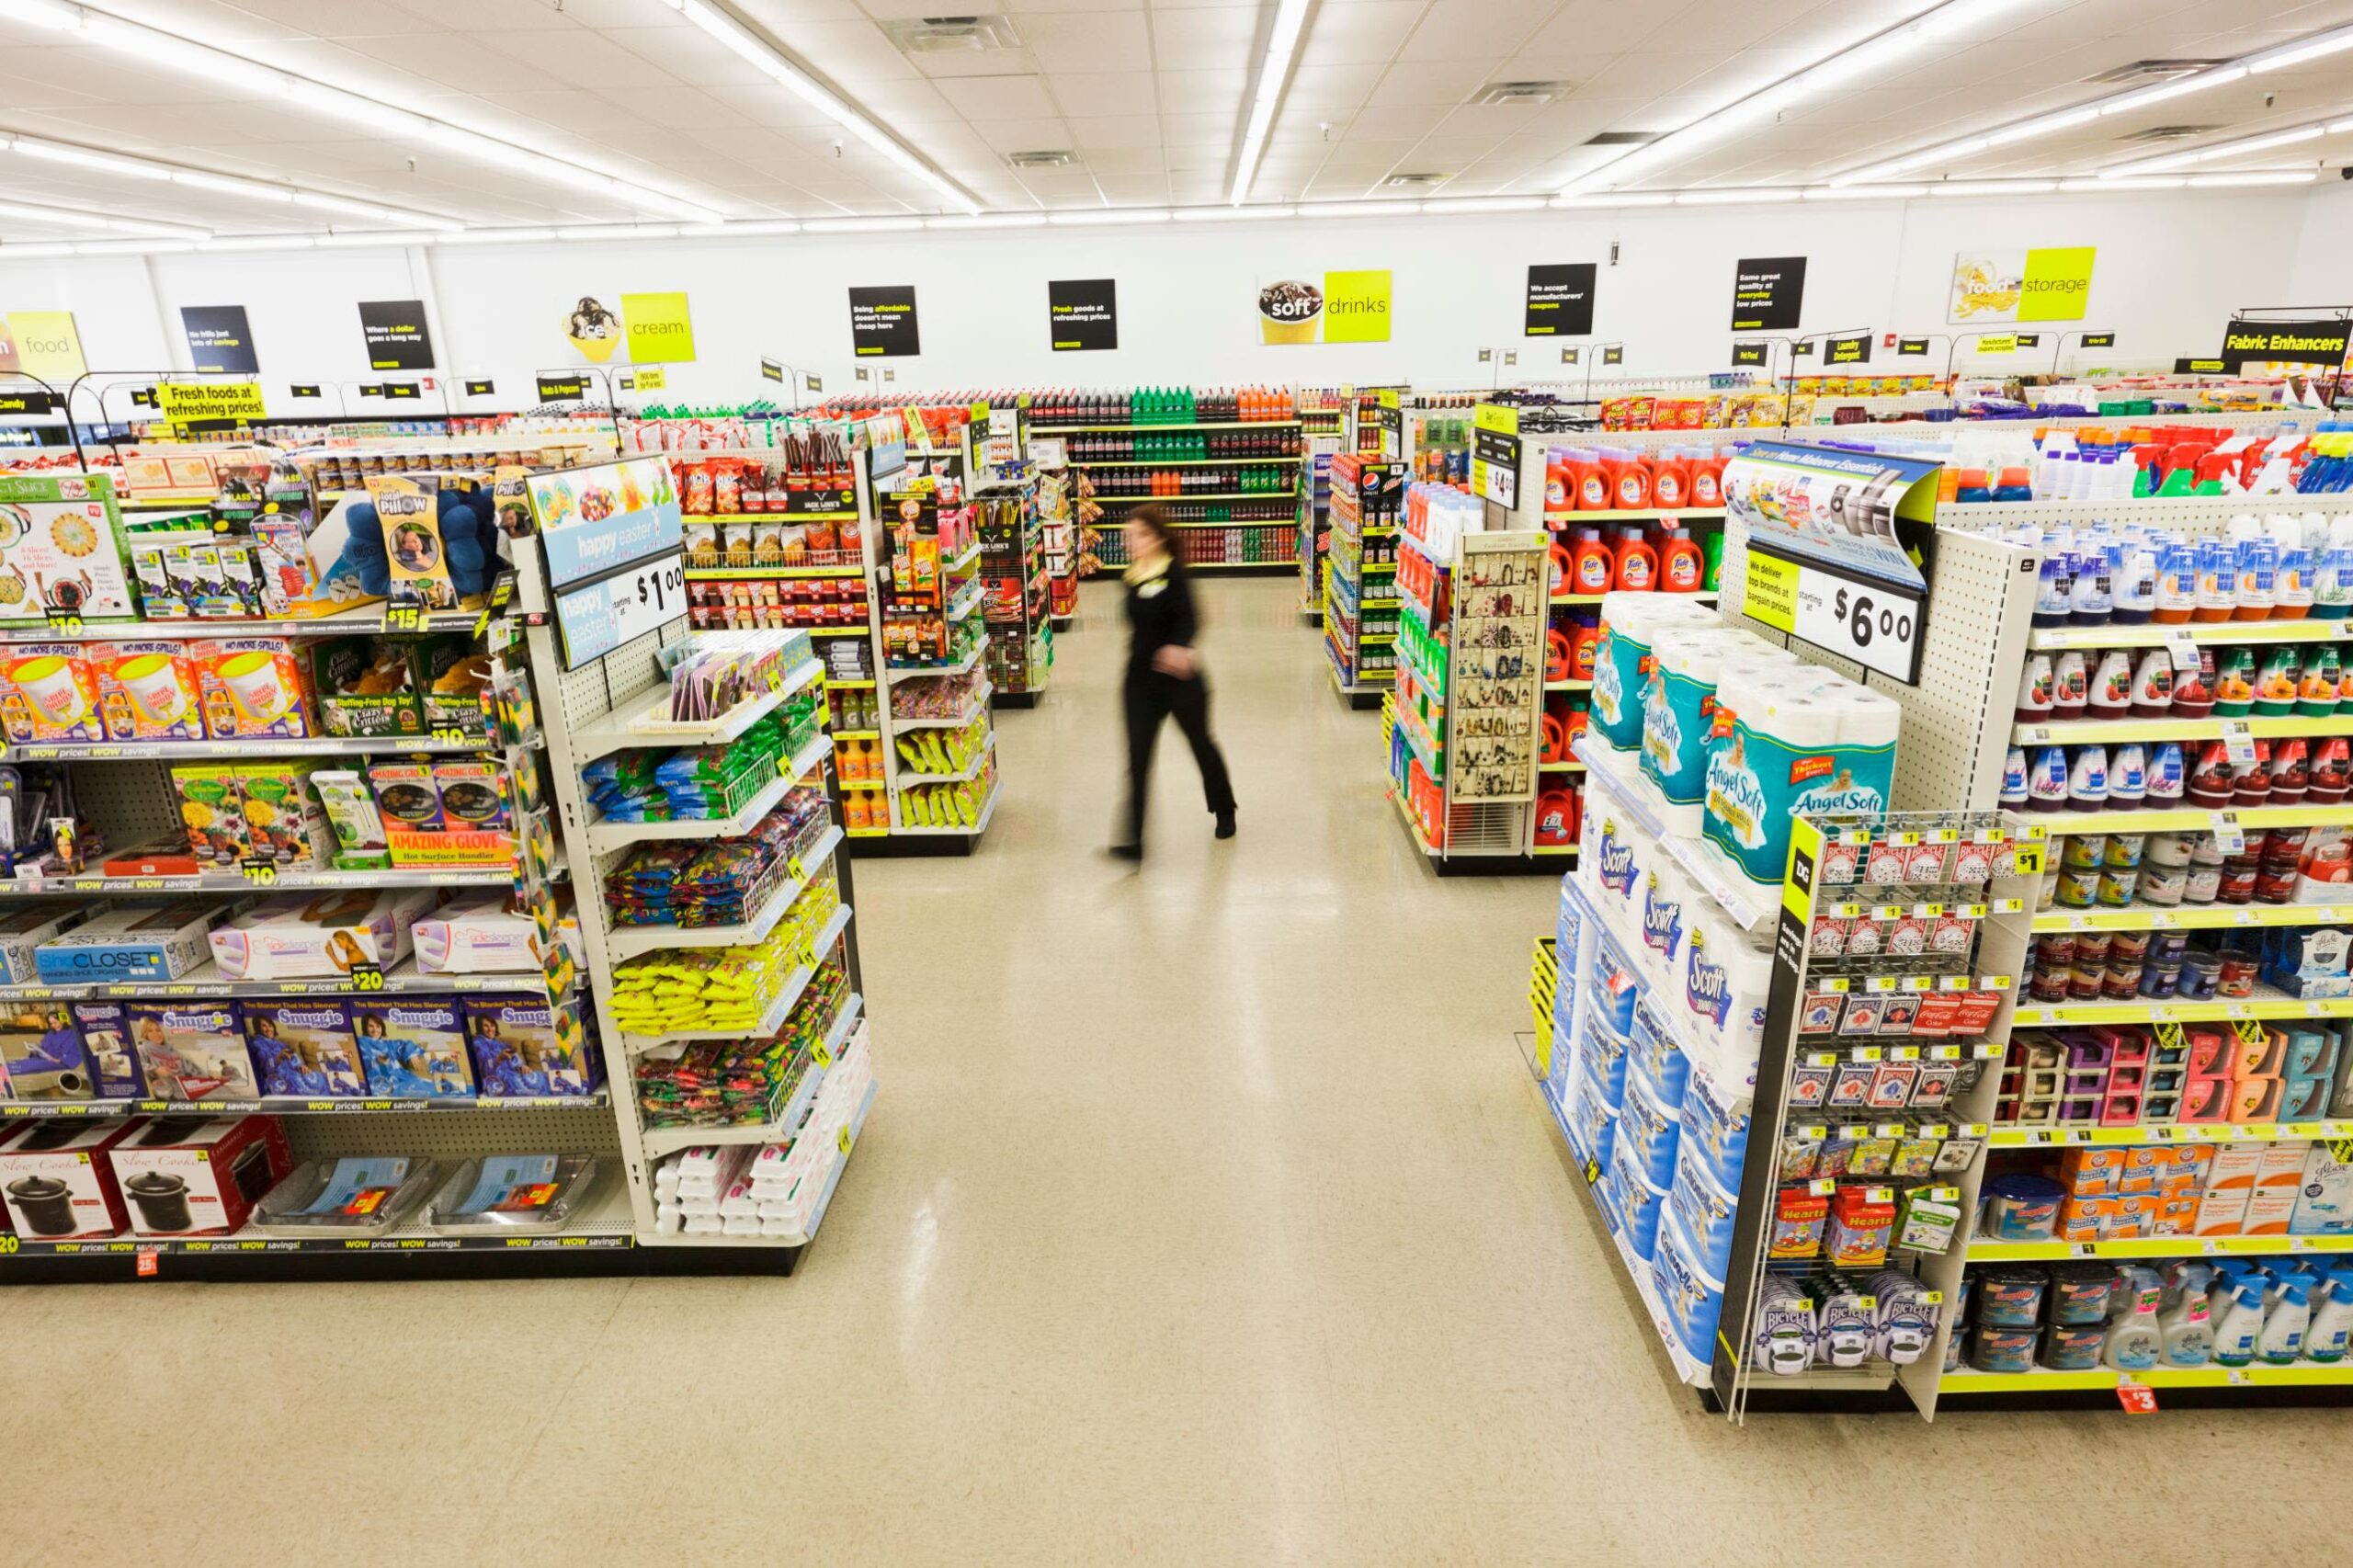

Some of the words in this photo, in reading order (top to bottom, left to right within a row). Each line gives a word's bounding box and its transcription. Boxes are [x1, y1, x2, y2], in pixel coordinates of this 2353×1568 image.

[2025, 276, 2087, 297] storage
[854, 305, 873, 313] Being
[1271, 297, 1312, 318] soft
[1328, 296, 1386, 314] drinks
[633, 321, 684, 336] cream
[26, 335, 69, 354] food
[2227, 335, 2268, 350] Fabric
[2269, 335, 2345, 351] Enhancers
[171, 386, 204, 400] Fresh
[207, 386, 237, 399] foods
[241, 386, 252, 398] at
[0, 398, 26, 410] Candy
[166, 401, 225, 416] refreshing
[228, 400, 264, 415] prices!
[381, 491, 400, 501] total
[577, 534, 617, 559] happy
[619, 521, 652, 546] easter
[1583, 560, 1598, 571] Tide
[1627, 559, 1643, 570] Tide
[1674, 557, 1689, 569] Tide
[1750, 561, 1760, 573] We
[1760, 562, 1782, 580] deliver
[1748, 575, 1760, 589] top
[1760, 578, 1781, 595] brands
[1781, 587, 1789, 597] at
[563, 588, 603, 618] happy
[1747, 591, 1770, 608] bargain
[1770, 598, 1792, 616] prices.
[1799, 590, 1823, 608] starting
[1805, 603, 1813, 612] at
[49, 617, 83, 637] $10
[388, 608, 418, 629] $15
[570, 615, 608, 646] easter
[336, 698, 381, 708] Stuffing-Free
[382, 698, 397, 708] Dog
[398, 696, 414, 707] Toy!
[355, 708, 381, 719] Crazy
[432, 729, 464, 748] $10
[29, 747, 58, 757] WOW
[59, 747, 90, 758] prices!
[93, 746, 121, 757] WOW
[122, 745, 160, 756] savings!
[1794, 760, 1832, 774] Thickest
[1707, 762, 1738, 794] Angel
[1737, 777, 1763, 821] Soft
[1793, 792, 1846, 814] Angel
[1846, 791, 1880, 812] Soft
[392, 835, 452, 849] AMAZING
[455, 833, 498, 848] GLOVE
[421, 851, 455, 861] Surface
[458, 851, 494, 859] Handler
[1602, 838, 1633, 874] Scott
[1873, 845, 1906, 858] BICYCLE
[1961, 844, 1992, 858] BICYCLE
[2019, 853, 2037, 871] $1
[244, 868, 275, 886] $10
[1796, 861, 1810, 883] DG
[75, 880, 102, 890] WOW
[104, 880, 134, 891] prices!
[137, 880, 164, 889] WOW
[165, 878, 202, 889] savings!
[1646, 893, 1679, 933] Scott
[74, 951, 155, 968] CLOSET
[353, 971, 382, 991] $20
[1689, 951, 1727, 1002] Scott
[368, 1001, 392, 1009] Blanket
[389, 1009, 453, 1028] Snuggie
[476, 1097, 502, 1108] WOW
[504, 1097, 533, 1108] prices!
[535, 1096, 561, 1107] WOW
[562, 1096, 597, 1107] savings!
[1693, 1070, 1730, 1131] Cottonelle
[5, 1106, 29, 1116] WOW
[31, 1106, 60, 1117] prices!
[62, 1105, 87, 1115] WOW
[88, 1105, 122, 1115] savings!
[1680, 1157, 1715, 1218] Cottonelle
[1783, 1208, 1825, 1219] Hearts
[1849, 1215, 1892, 1226] Hearts
[346, 1239, 370, 1248] WOW
[371, 1239, 399, 1250] prices!
[401, 1239, 426, 1248] WOW
[427, 1238, 460, 1249] savings!
[1767, 1311, 1809, 1330] BICYCLE
[1829, 1306, 1870, 1324] BICYCLE
[1892, 1301, 1931, 1322] BICYCLE
[2132, 1392, 2155, 1411] $3
